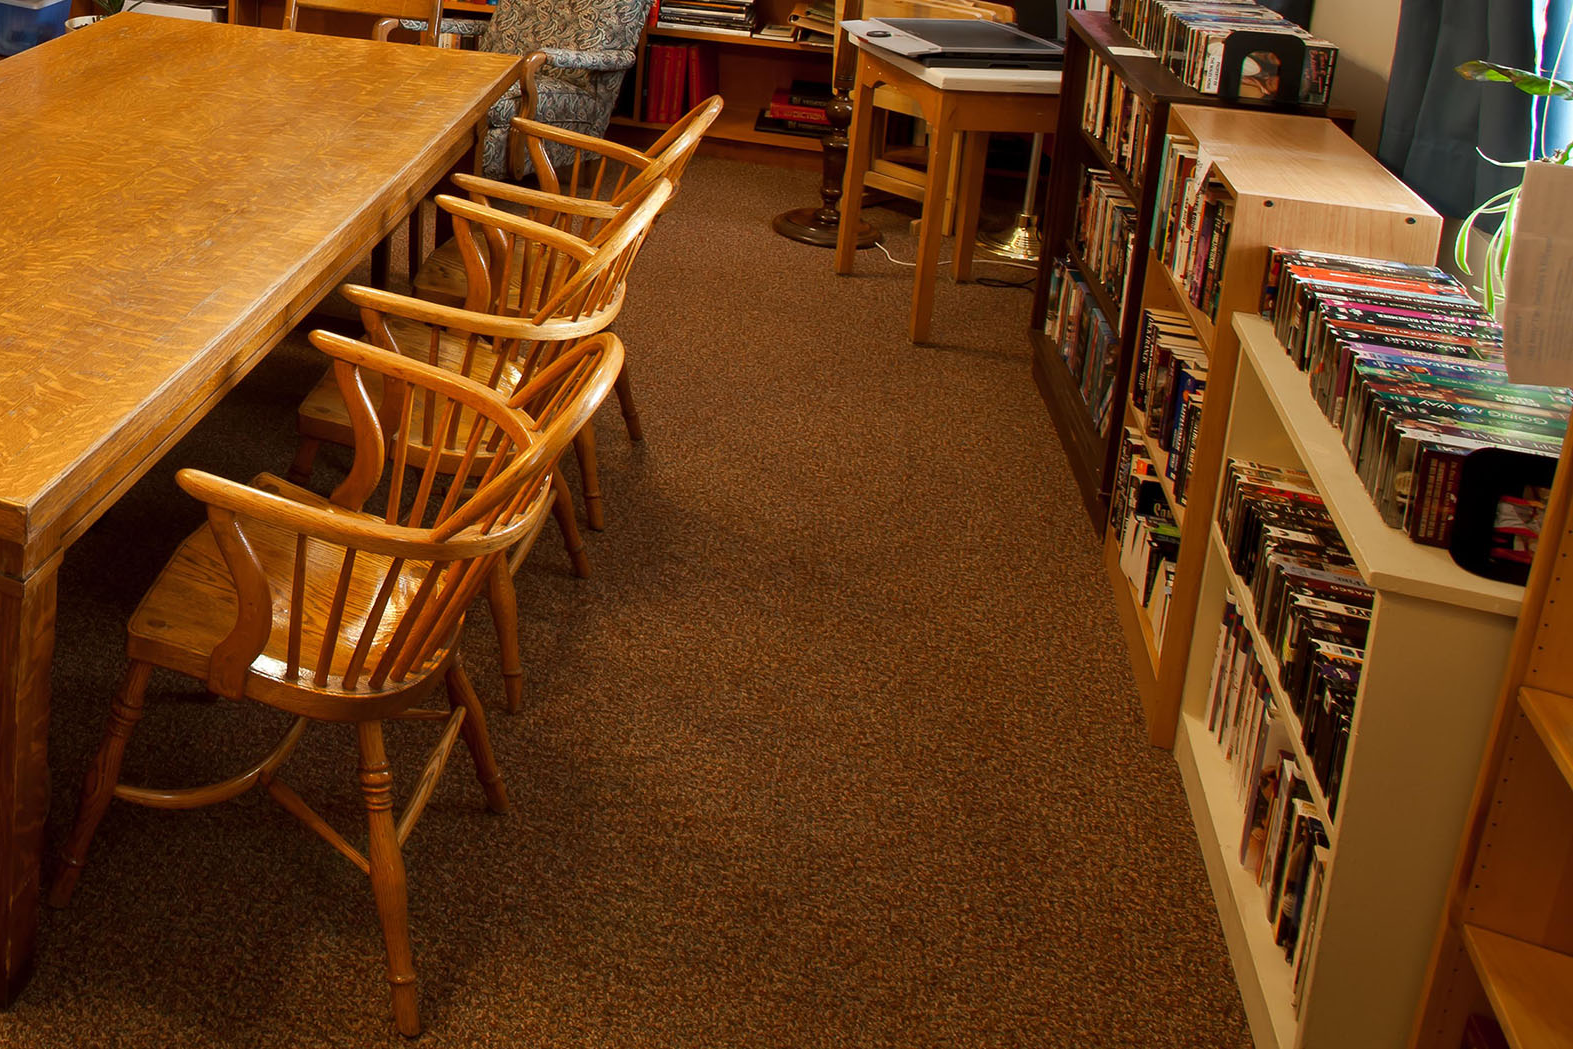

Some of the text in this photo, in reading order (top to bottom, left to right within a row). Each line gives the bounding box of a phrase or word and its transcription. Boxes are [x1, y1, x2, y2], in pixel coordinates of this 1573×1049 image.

[1419, 398, 1549, 427] GOING MY WAY
